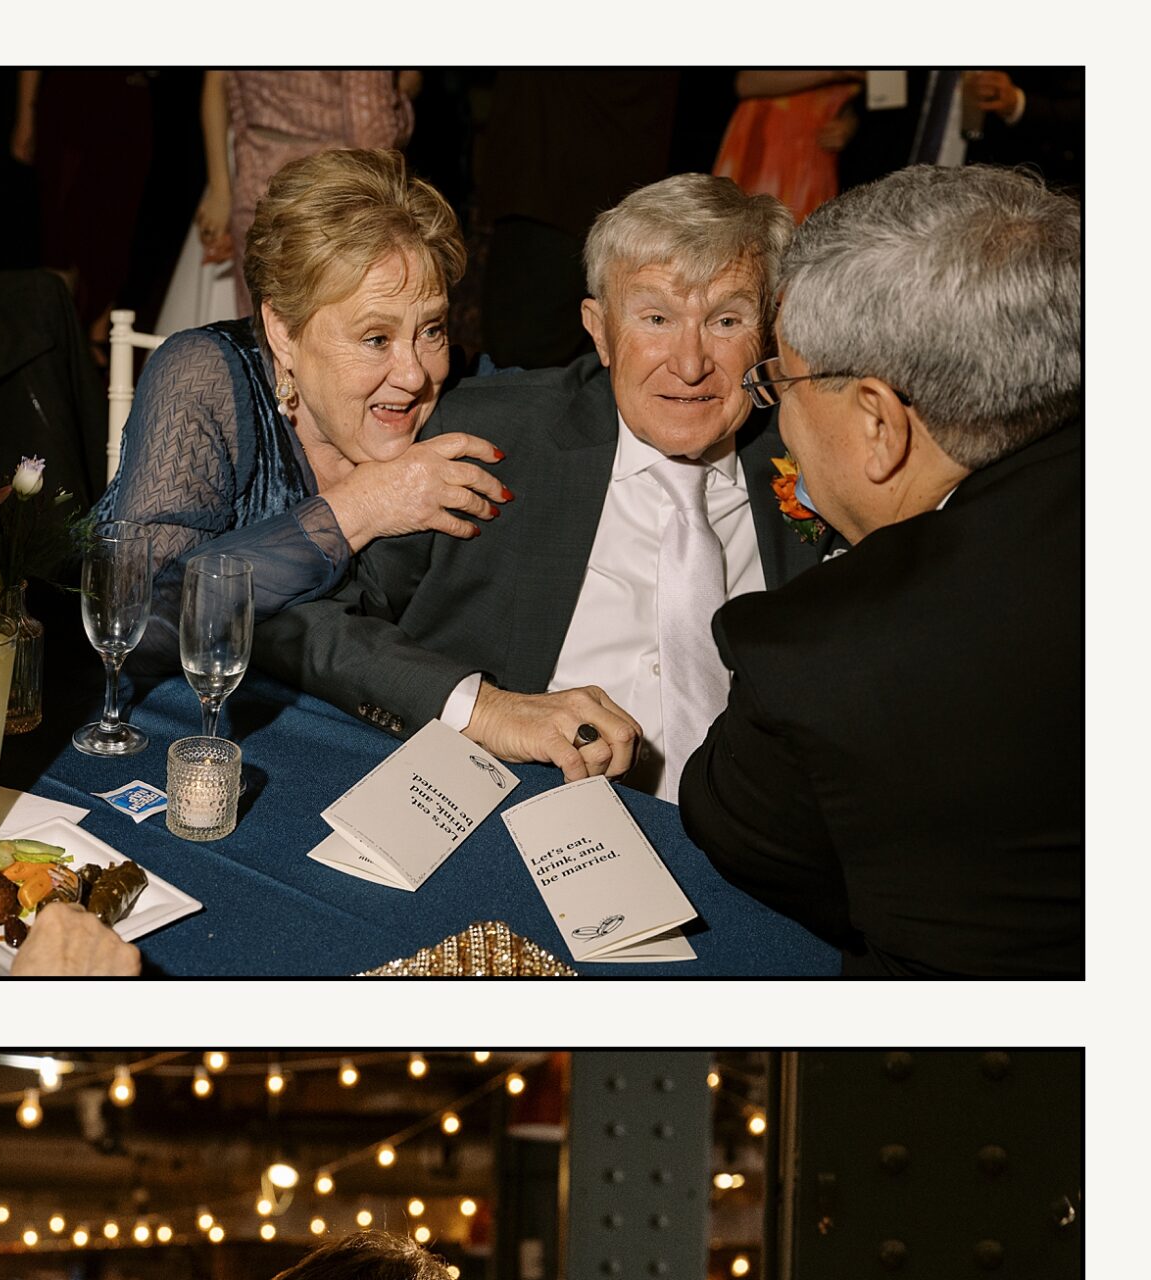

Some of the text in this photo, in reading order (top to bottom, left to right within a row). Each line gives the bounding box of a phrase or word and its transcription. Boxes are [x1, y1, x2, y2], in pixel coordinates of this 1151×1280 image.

[128, 791, 160, 812] FRESH
[409, 784, 466, 834] drink, and
[411, 771, 459, 813] married.
[410, 795, 459, 842] Let's eat,
[459, 809, 475, 828] be
[530, 835, 593, 867] Let's eat,
[535, 841, 606, 878] drink, and
[540, 850, 622, 888] be married.
